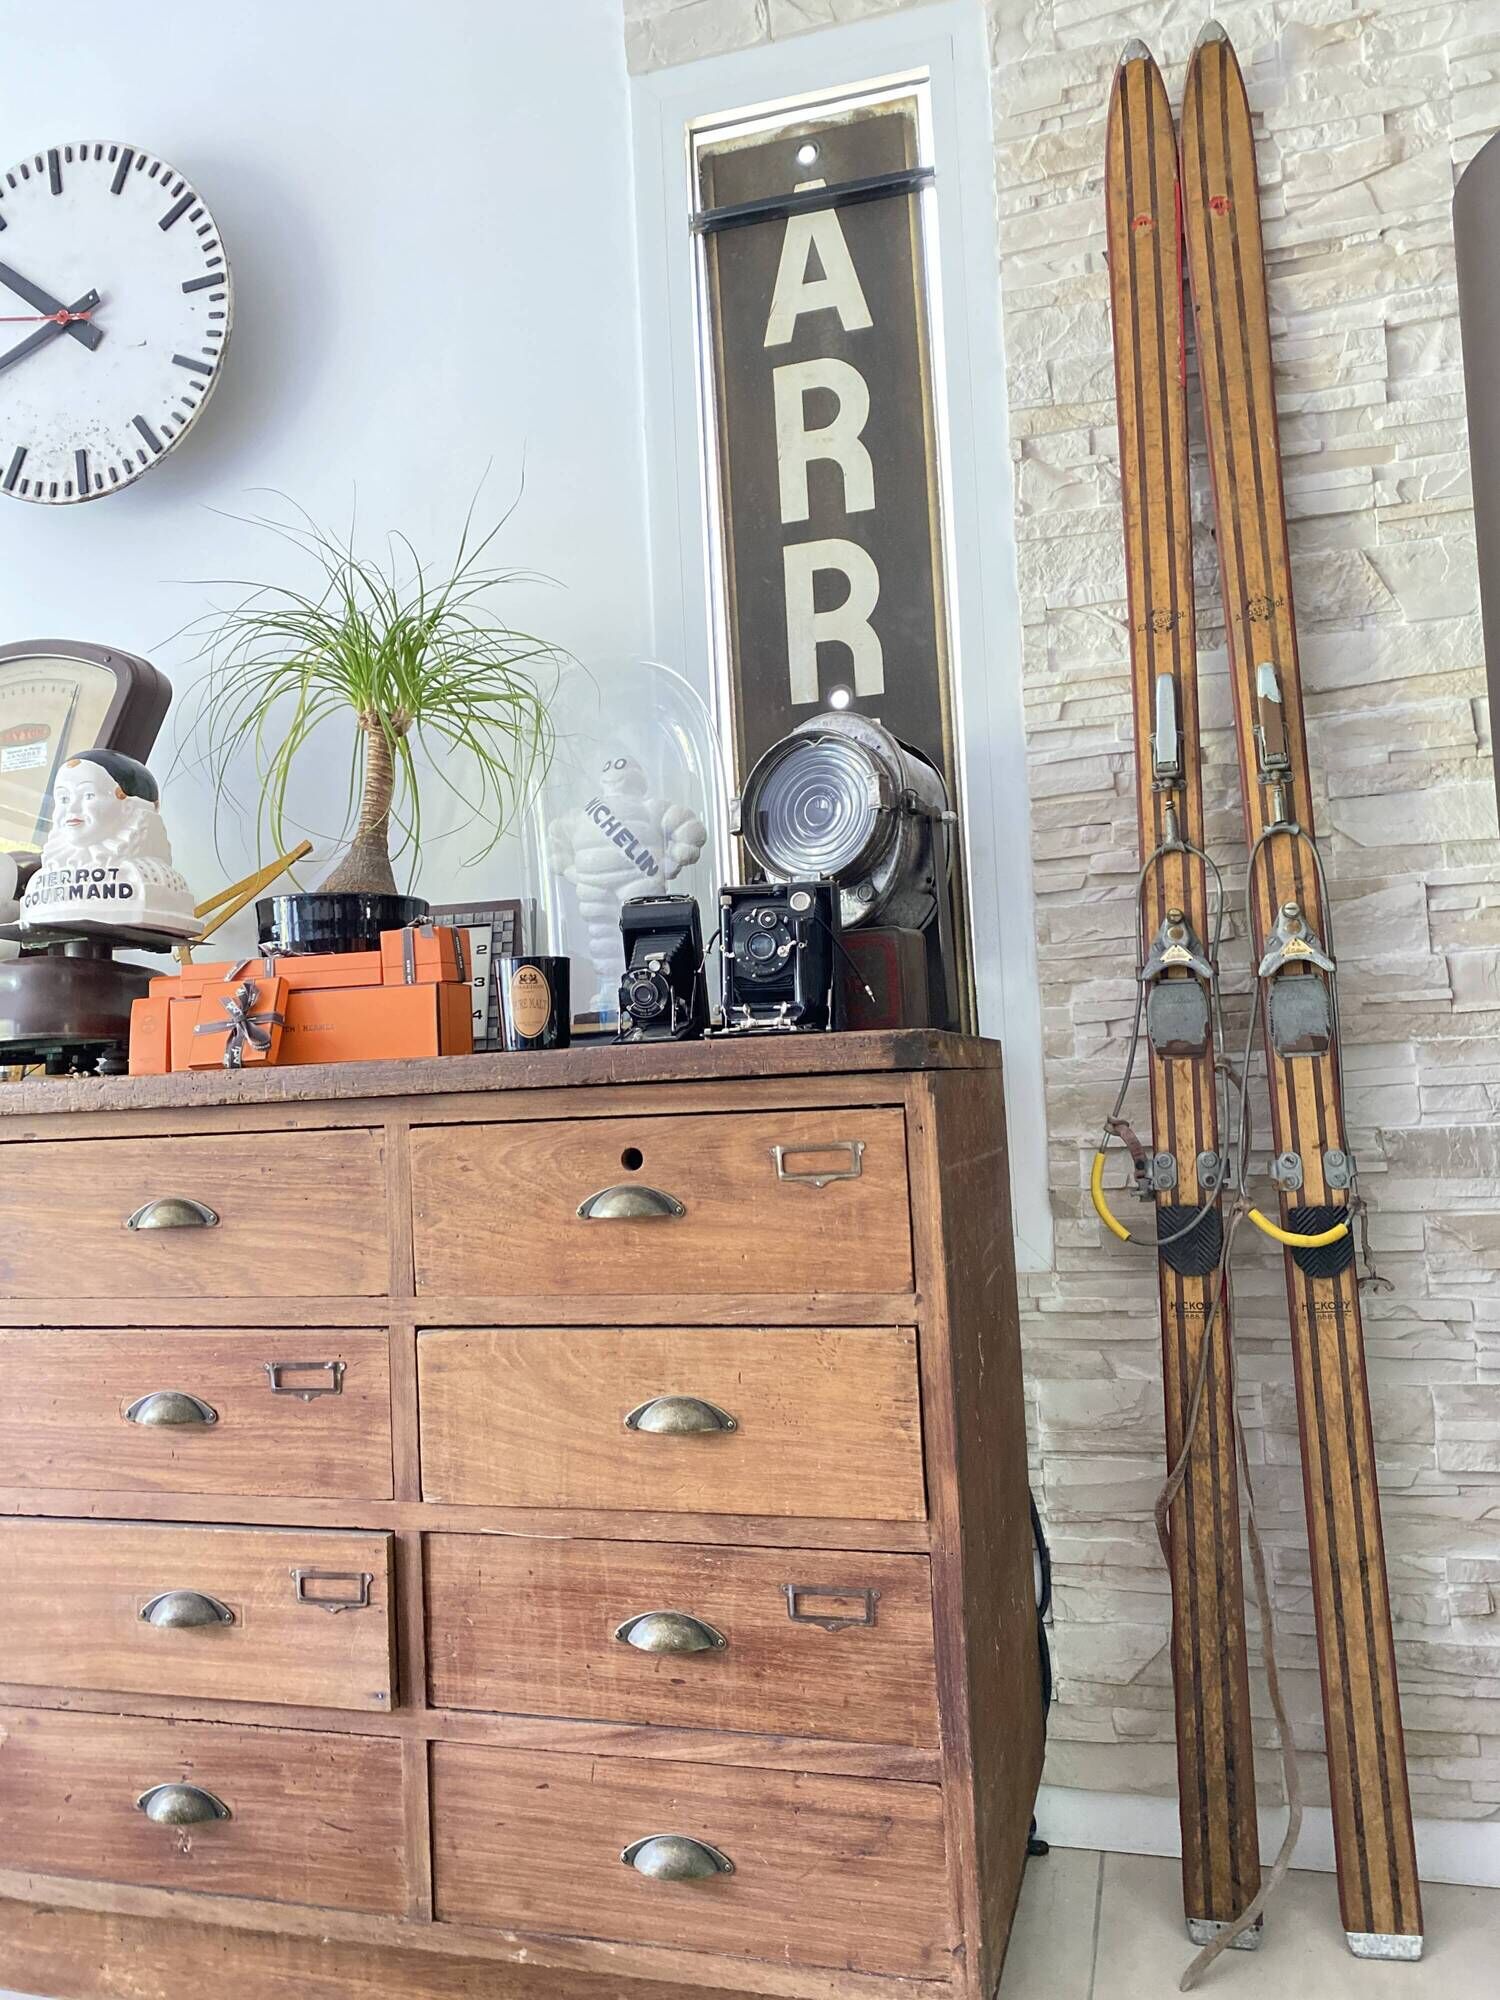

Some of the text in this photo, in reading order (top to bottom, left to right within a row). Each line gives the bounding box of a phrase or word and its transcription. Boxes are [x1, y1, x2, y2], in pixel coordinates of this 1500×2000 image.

[763, 178, 885, 722] ARR
[36, 868, 120, 889] PIERROT
[24, 883, 134, 908] GOURMAND
[476, 944, 488, 955] 2
[473, 977, 486, 988] 3
[472, 1009, 483, 1020] 4
